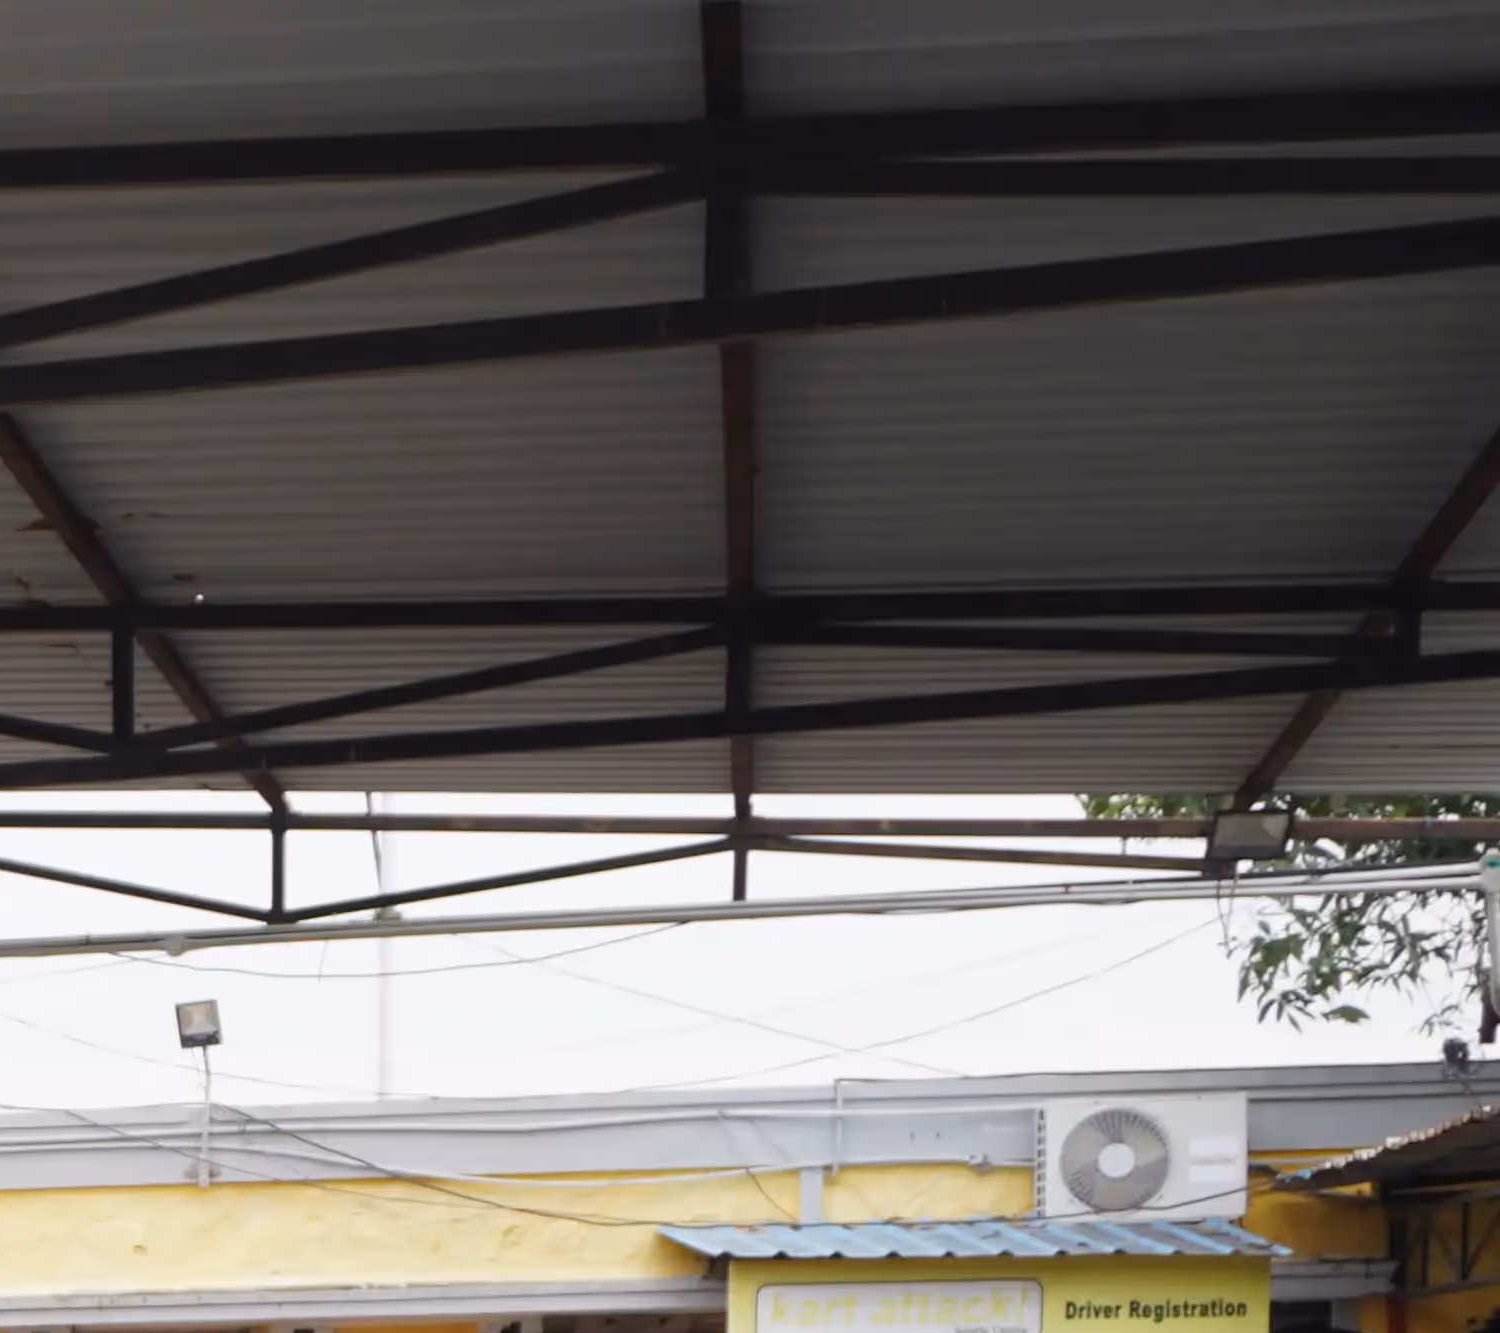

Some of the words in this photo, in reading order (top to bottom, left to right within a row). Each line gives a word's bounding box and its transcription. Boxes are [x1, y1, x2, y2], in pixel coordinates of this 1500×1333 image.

[769, 1291, 858, 1327] kart
[1064, 1300, 1122, 1320] Driver
[1128, 1298, 1248, 1324] Registration
